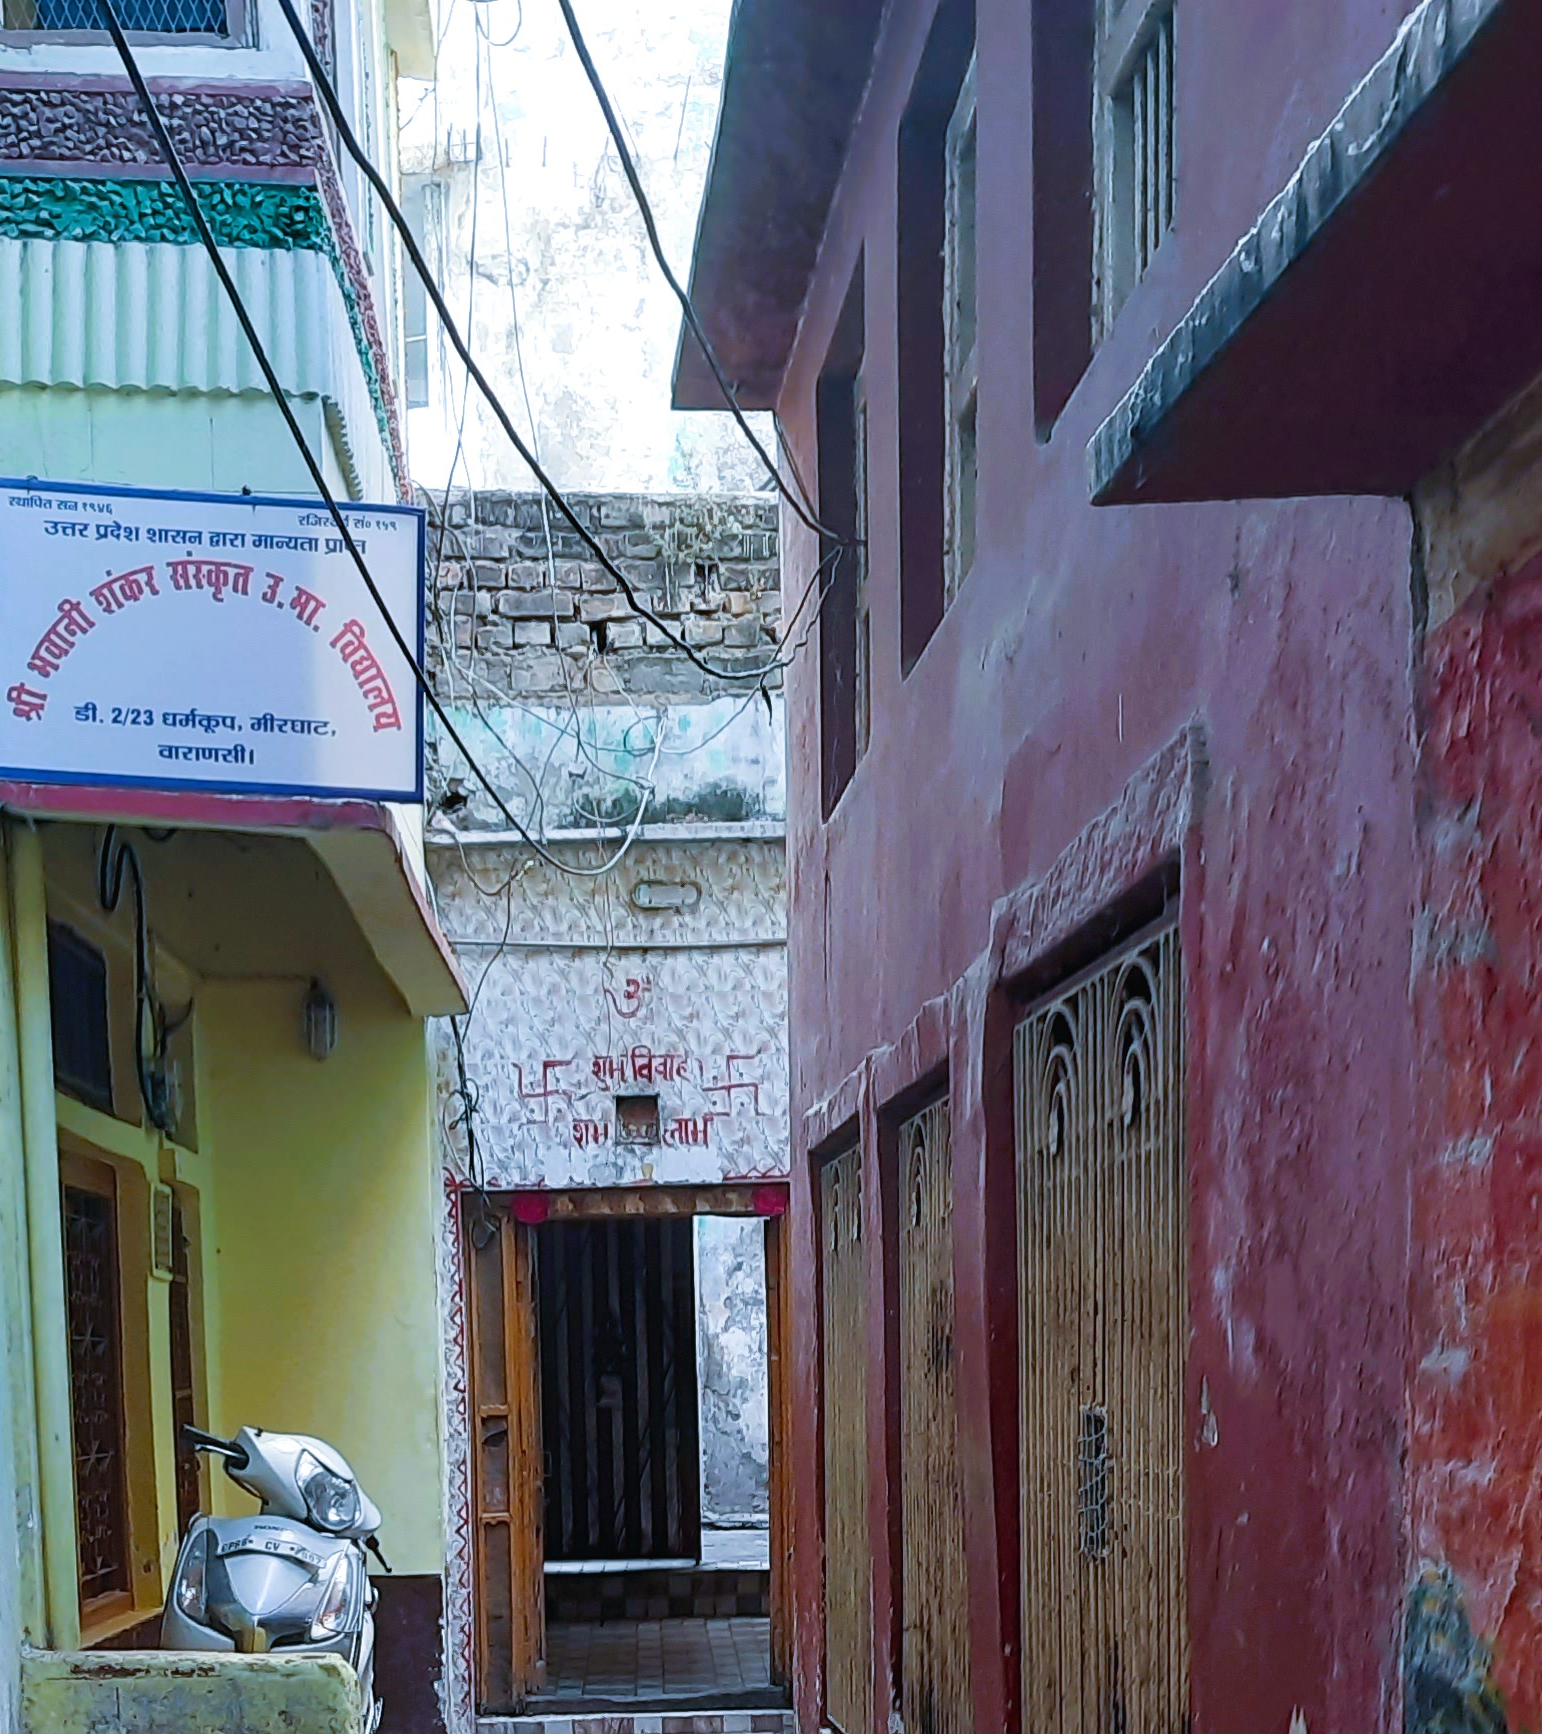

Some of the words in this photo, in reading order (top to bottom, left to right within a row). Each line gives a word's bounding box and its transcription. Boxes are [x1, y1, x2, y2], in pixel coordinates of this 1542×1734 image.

[8, 494, 52, 510] स्थापित
[43, 519, 90, 538] उत्तर
[95, 520, 140, 542] प्रदेश
[146, 527, 203, 546] शासन
[208, 531, 246, 548] द्वारा
[251, 533, 319, 553] मान्यता
[6, 681, 48, 722] श्री
[27, 598, 96, 679] भवानी
[89, 570, 159, 614] शंकर
[166, 550, 254, 603] संस्कृत
[329, 618, 402, 733] विद्यालय
[73, 702, 104, 724] डी.
[111, 707, 154, 726] 2/23
[162, 708, 243, 734] धर्मकूप,
[250, 712, 336, 737] मीरघाट,
